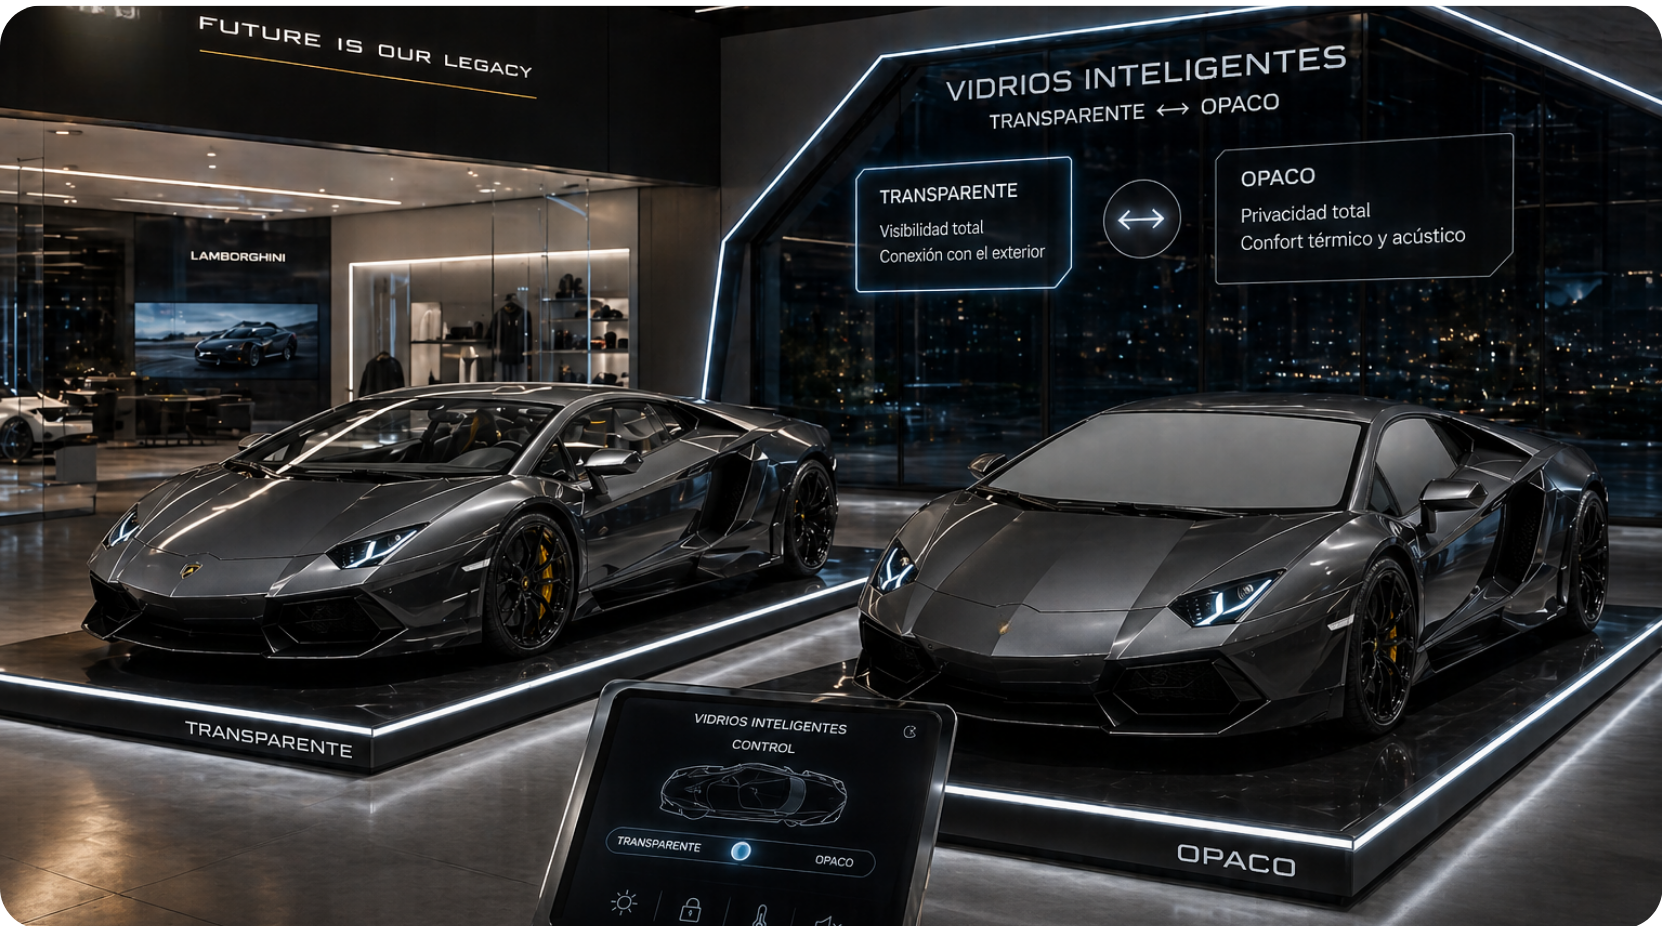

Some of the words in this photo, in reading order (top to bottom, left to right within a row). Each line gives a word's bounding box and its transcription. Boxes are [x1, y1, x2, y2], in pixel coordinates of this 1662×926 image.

[199, 15, 322, 49] FUTURE
[338, 37, 363, 54] IS
[378, 43, 431, 64] OUR
[444, 54, 533, 79] LEGACY
[945, 70, 1072, 102] VIDRIOS
[1085, 44, 1347, 90] INTELIGENTES
[989, 103, 1145, 130] TRANSPARENTE
[1201, 93, 1280, 115] OPACO
[1241, 167, 1316, 188] OPACO
[879, 182, 1018, 204] TRANSPARENTE
[1241, 203, 1327, 224] Privacidad
[1331, 201, 1371, 220] total
[879, 221, 949, 238] Visibilidad
[951, 219, 984, 236] total
[1240, 233, 1304, 251] Confort
[1307, 230, 1373, 249] térmico
[1377, 233, 1389, 251] y
[1392, 226, 1466, 245] acústico
[190, 250, 286, 263] LAMBORGHINI
[879, 247, 943, 264] Conexión
[946, 249, 972, 262] con
[976, 245, 988, 261] el
[992, 244, 1046, 260] exterior
[694, 713, 748, 727] VIDRIOS
[750, 717, 848, 735] INTELIGENTES
[185, 720, 353, 760] TRANSPARENTE
[732, 739, 796, 754] CONTROL
[617, 835, 702, 853] TRANSPARENTE
[815, 854, 854, 868] OPACO
[1177, 843, 1296, 878] OPACO
